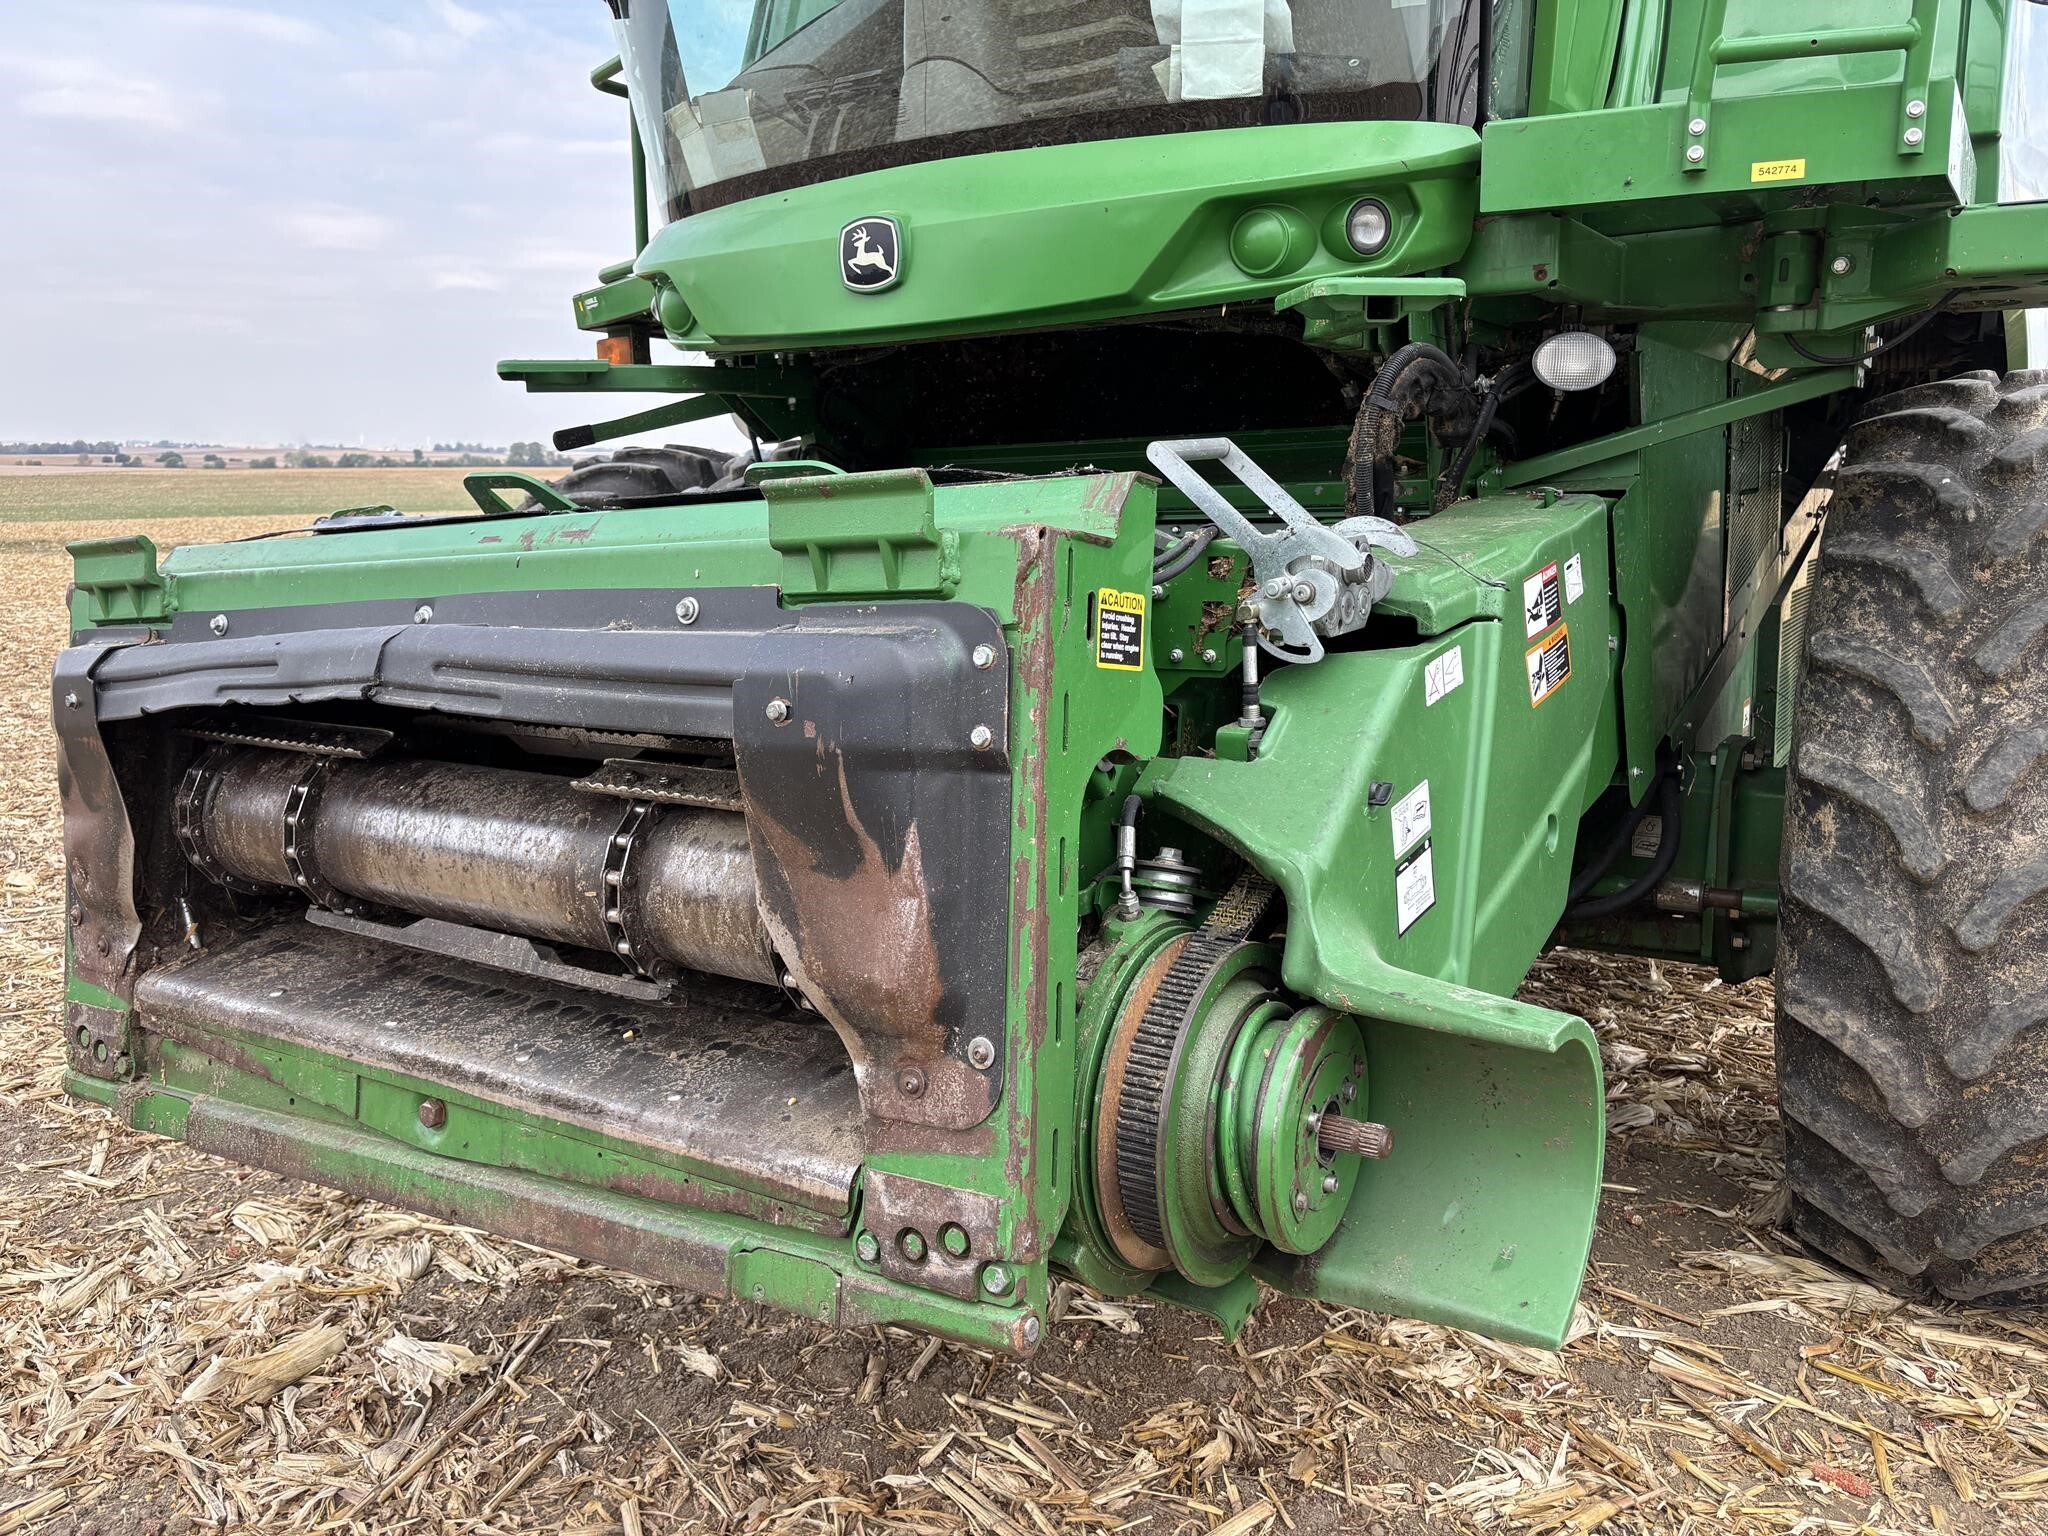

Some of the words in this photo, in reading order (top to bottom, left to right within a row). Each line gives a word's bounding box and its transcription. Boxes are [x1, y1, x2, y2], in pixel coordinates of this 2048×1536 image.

[1758, 164, 1797, 176] 542774
[1107, 593, 1143, 611] CAUTION
[1102, 611, 1116, 620] Avoid
